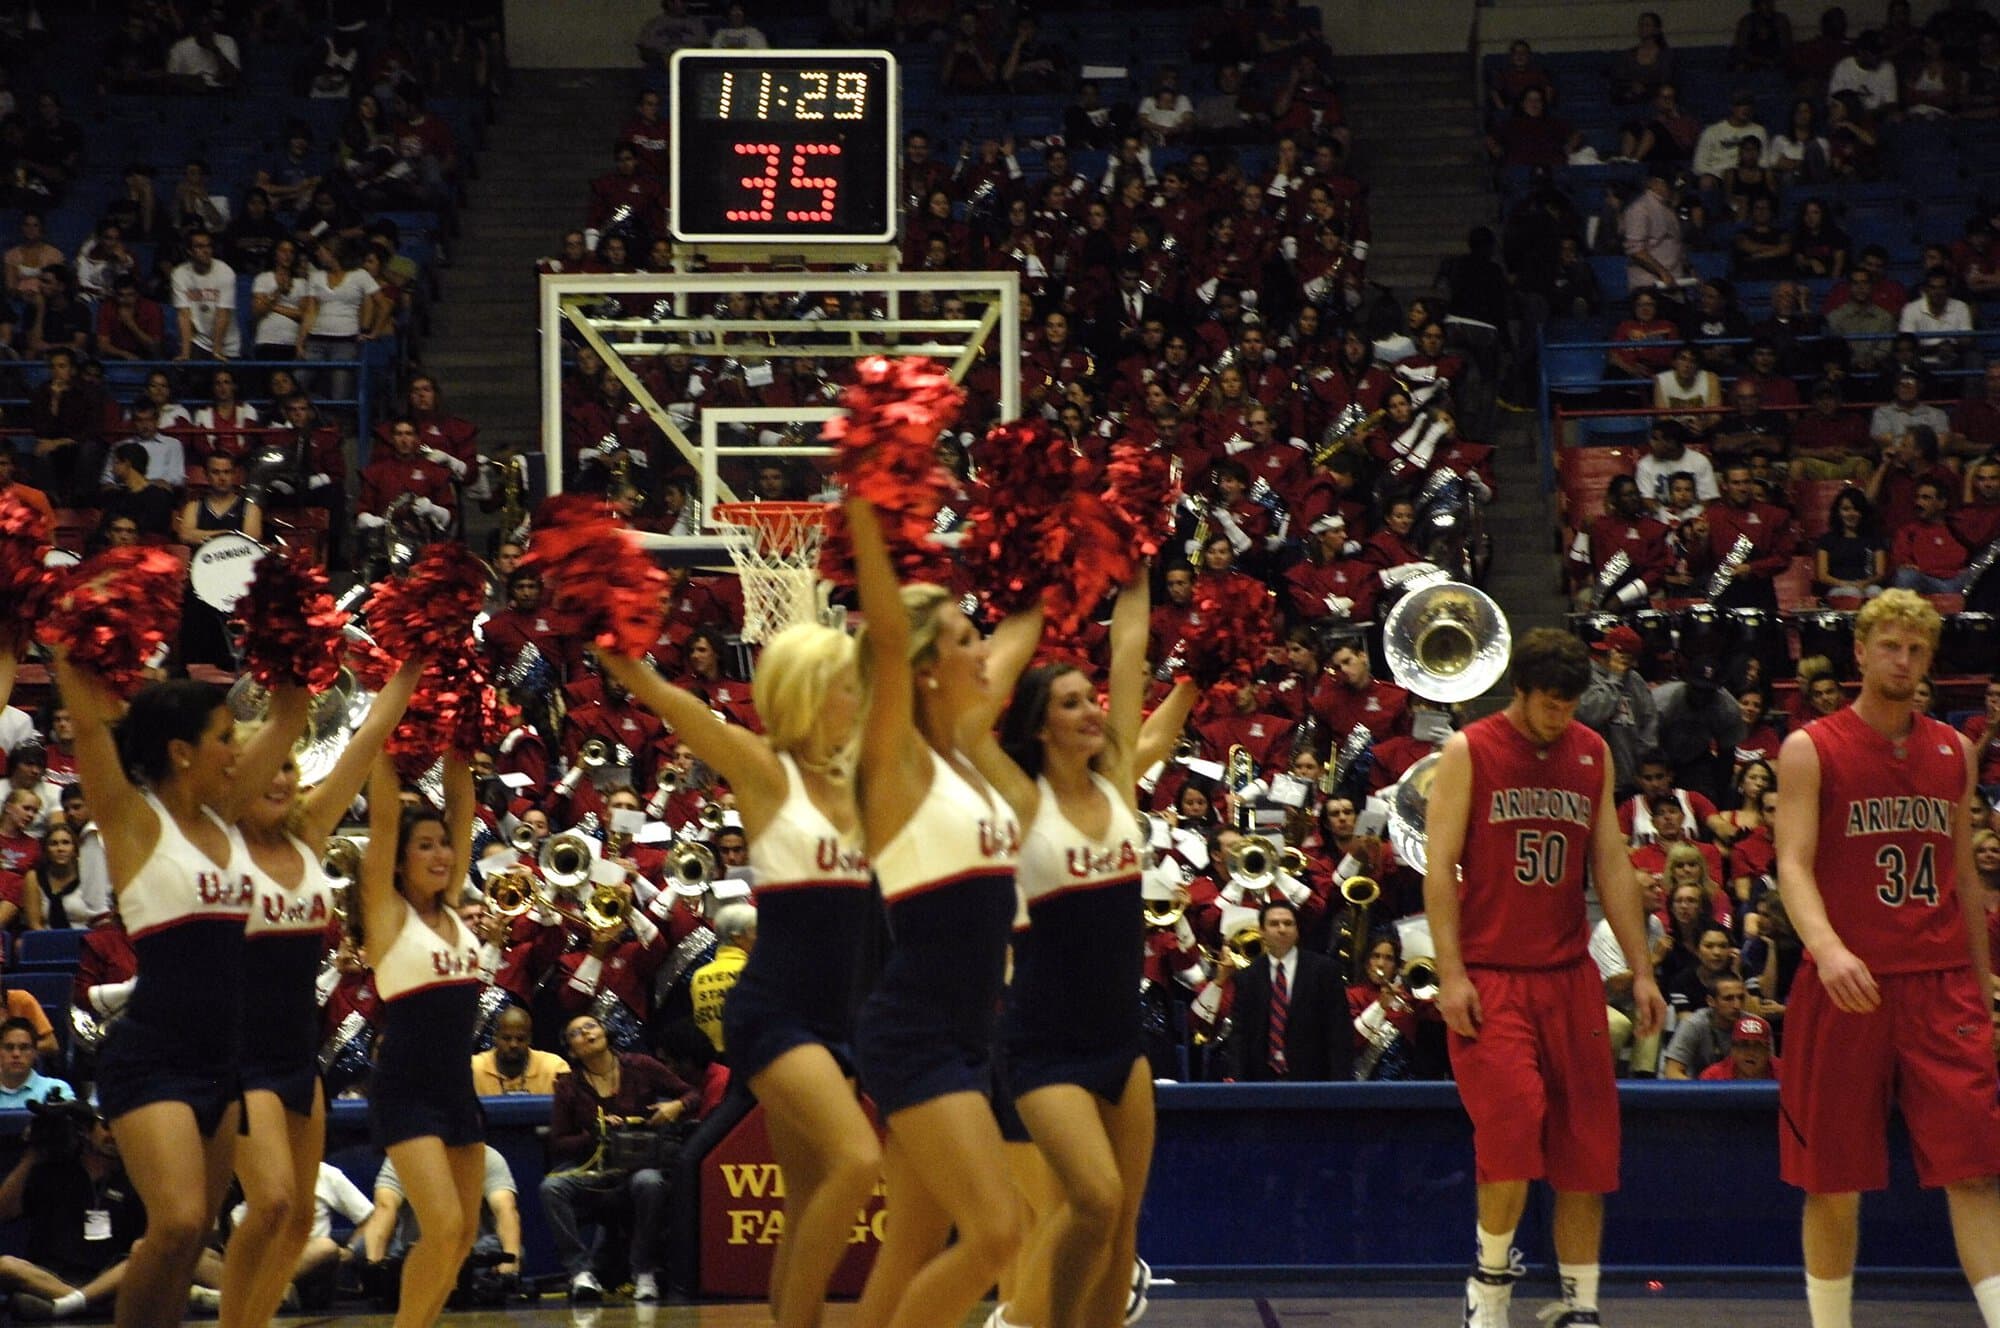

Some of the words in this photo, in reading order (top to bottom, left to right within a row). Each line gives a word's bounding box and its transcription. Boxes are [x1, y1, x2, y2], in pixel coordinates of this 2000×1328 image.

[719, 72, 867, 119] 11:29
[726, 144, 841, 221] 35
[1488, 787, 1592, 830] ARIZONA
[1845, 796, 1957, 838] ARIZON
[1515, 829, 1568, 886] 50
[1876, 843, 1939, 907] 34
[697, 972, 738, 985] EVEN
